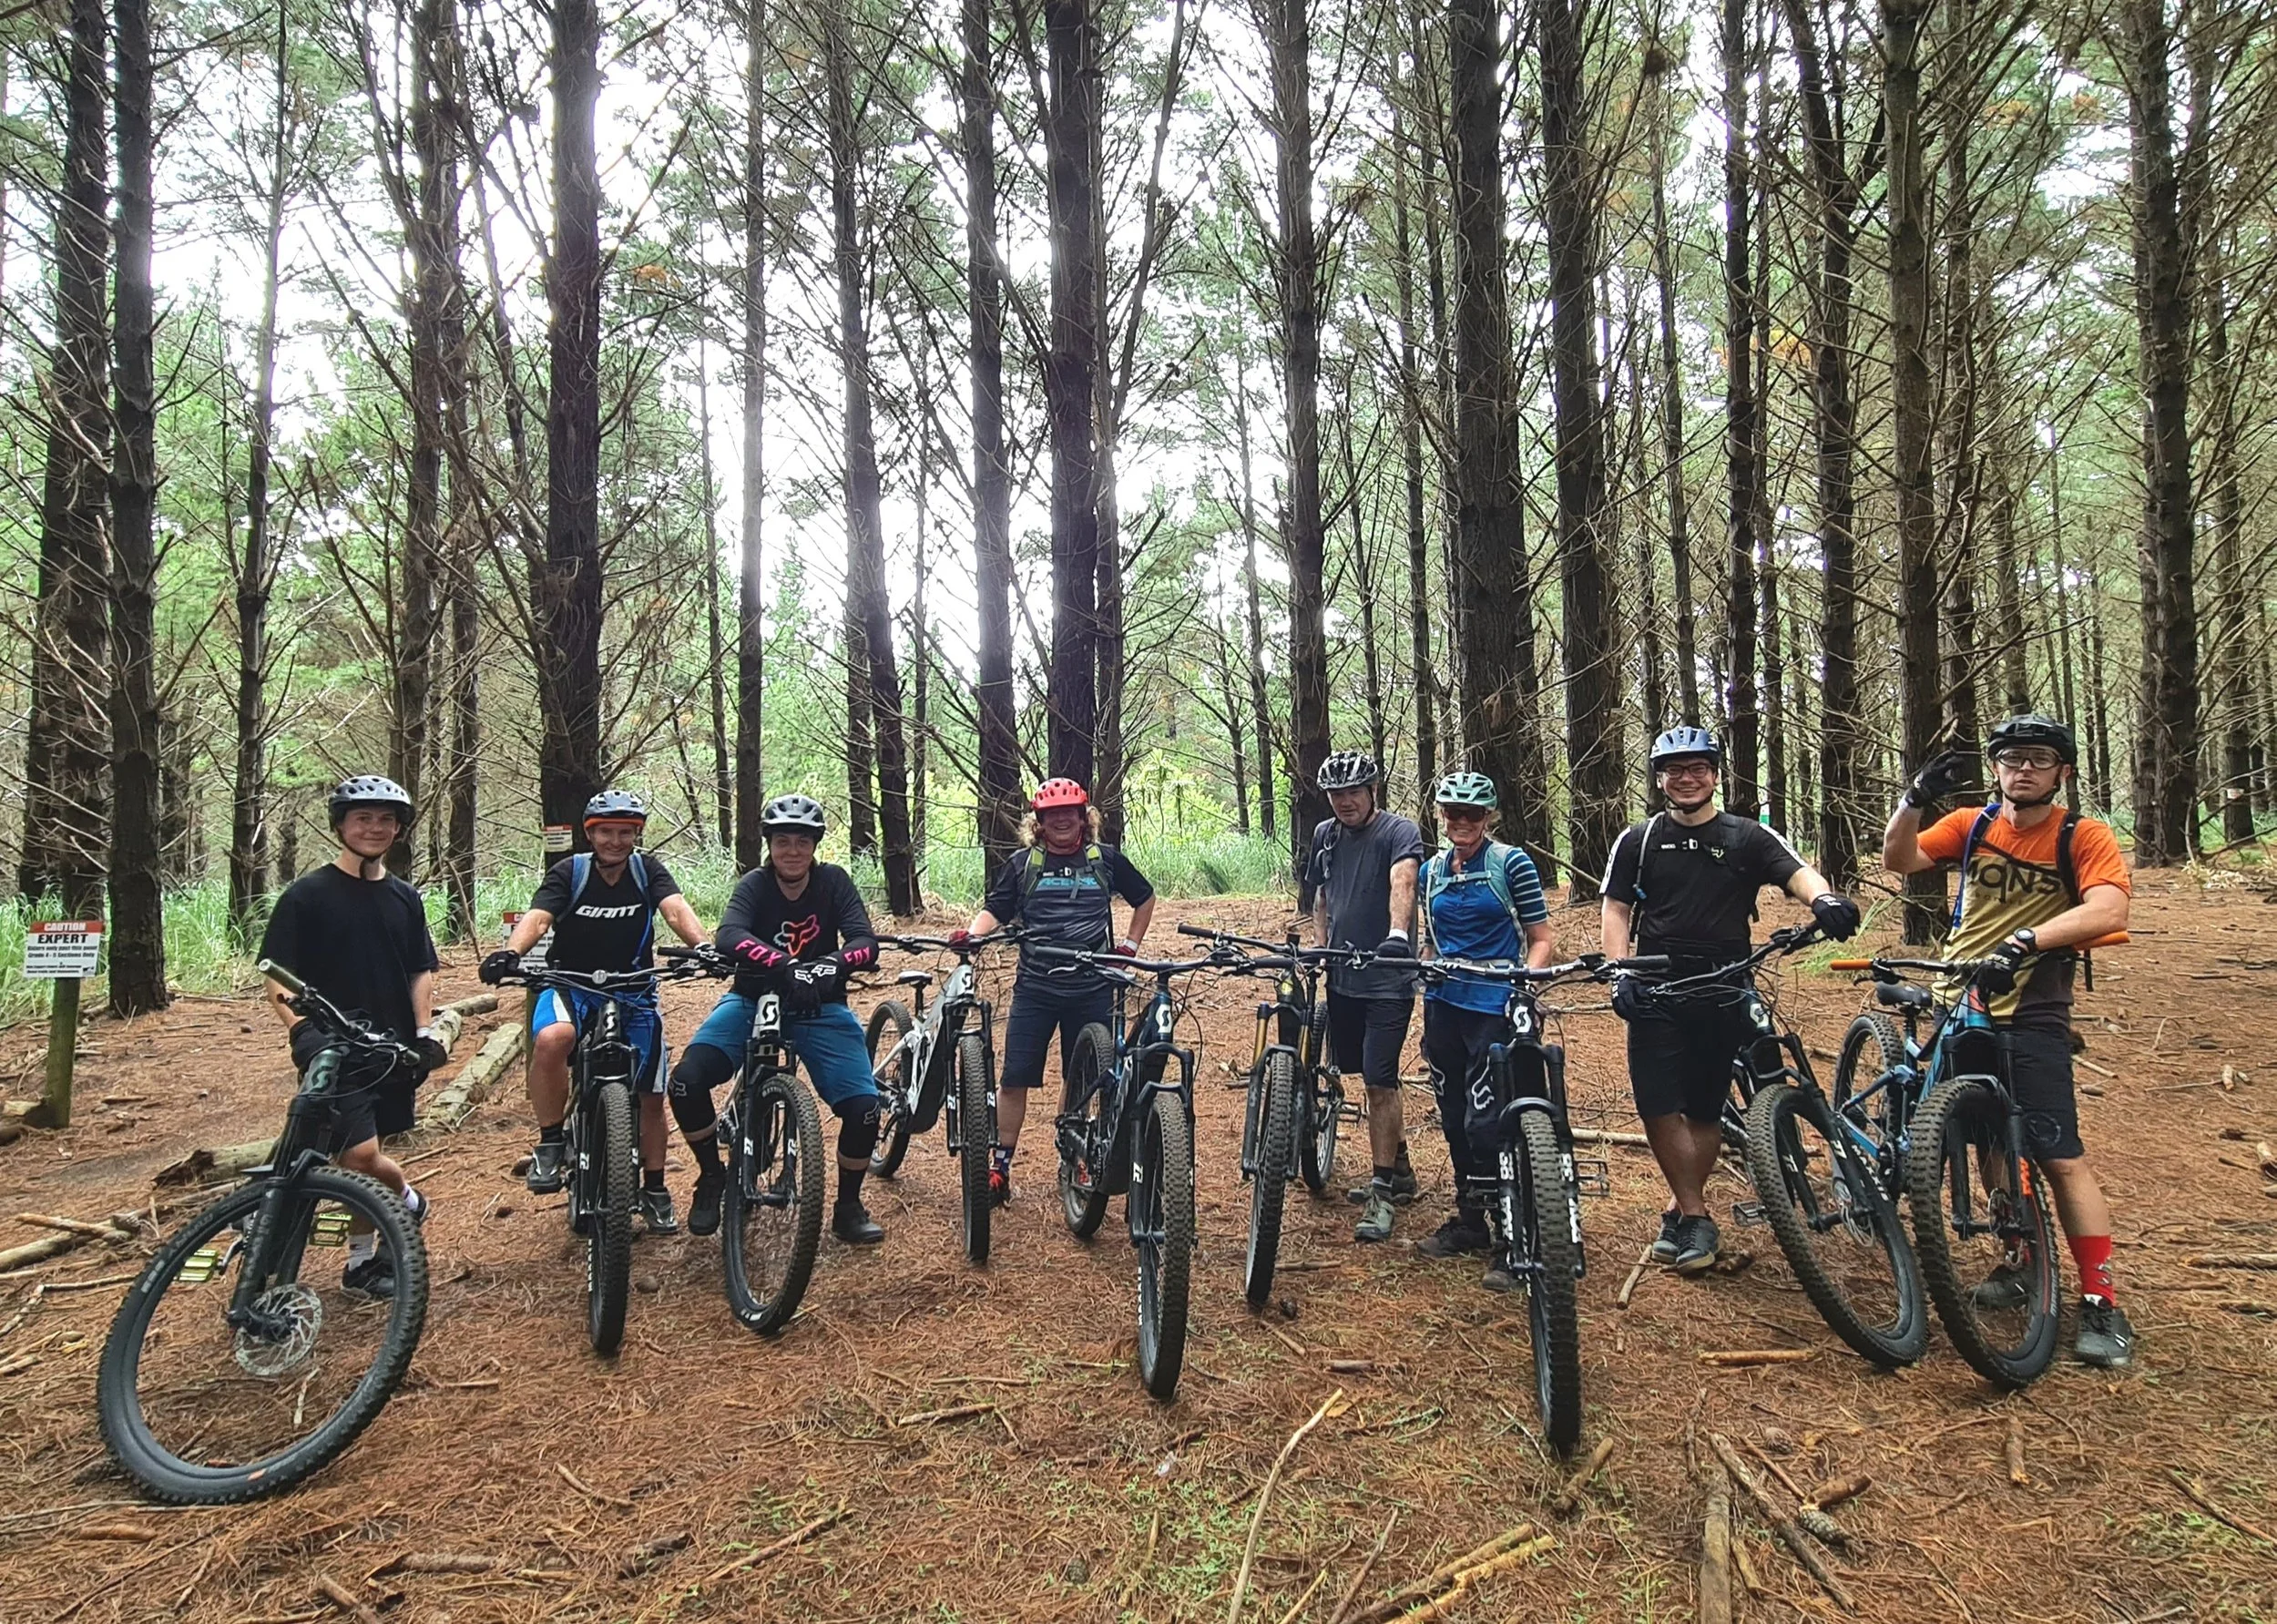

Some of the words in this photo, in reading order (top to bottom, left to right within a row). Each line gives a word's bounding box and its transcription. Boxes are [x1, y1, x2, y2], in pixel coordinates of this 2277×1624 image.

[576, 904, 642, 918] GIANT
[44, 922, 87, 932] CAUTION
[37, 934, 88, 944] EXPERT
[735, 939, 782, 967] FOX
[1851, 1144, 1889, 1201] MAXXIS
